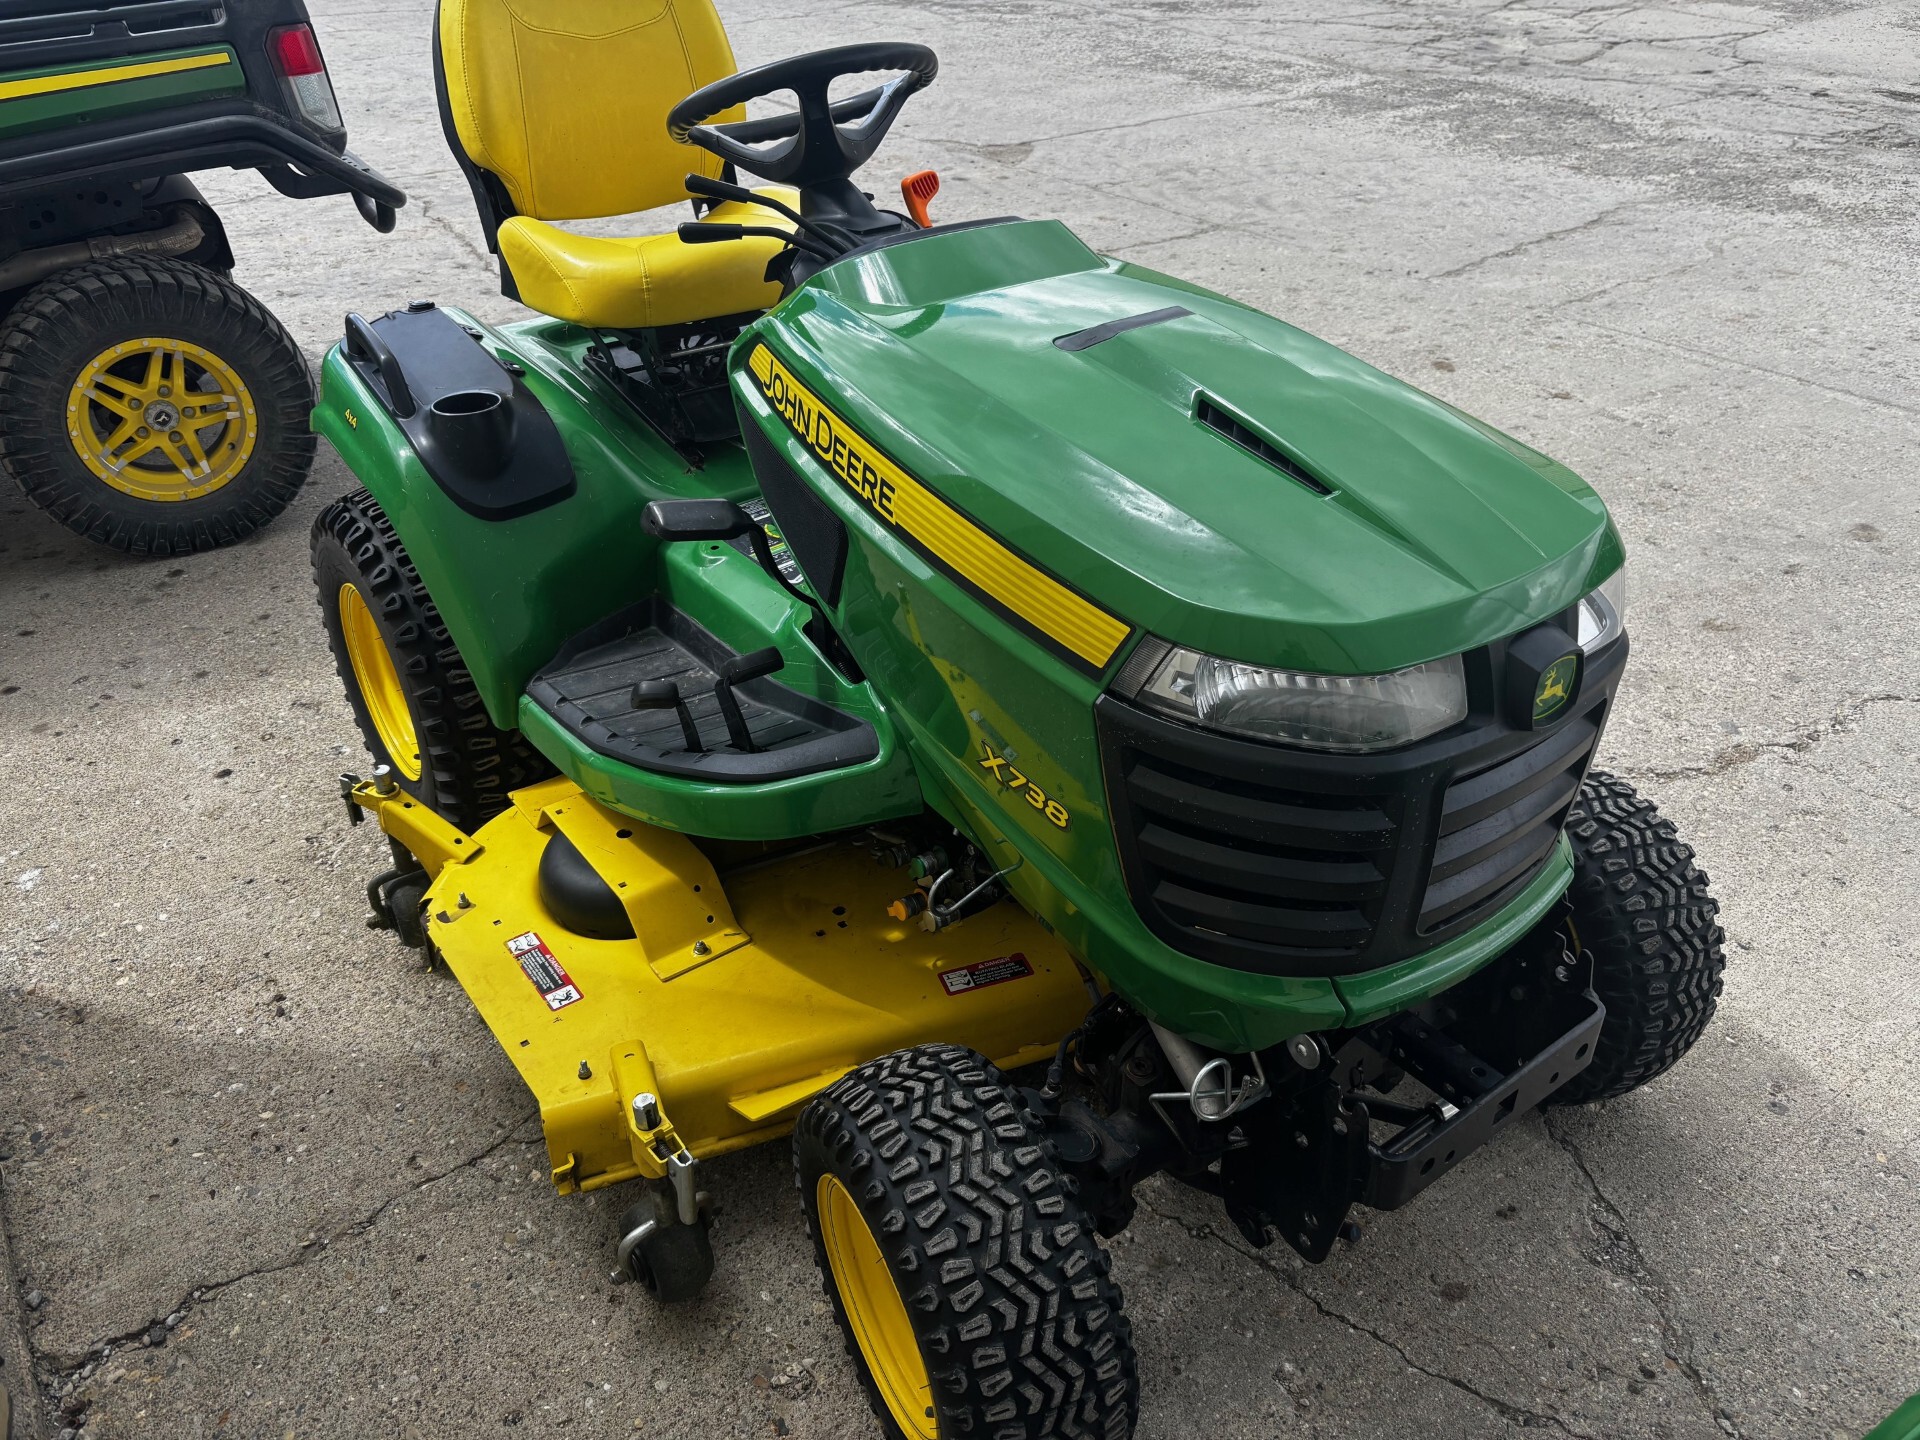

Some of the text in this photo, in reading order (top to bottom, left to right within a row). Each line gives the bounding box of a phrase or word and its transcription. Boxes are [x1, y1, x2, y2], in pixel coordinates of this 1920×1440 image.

[763, 358, 896, 522] JOHN DEERE
[979, 742, 1070, 829] X738
[548, 956, 566, 976] DANGER
[984, 957, 1010, 967] DANGER
